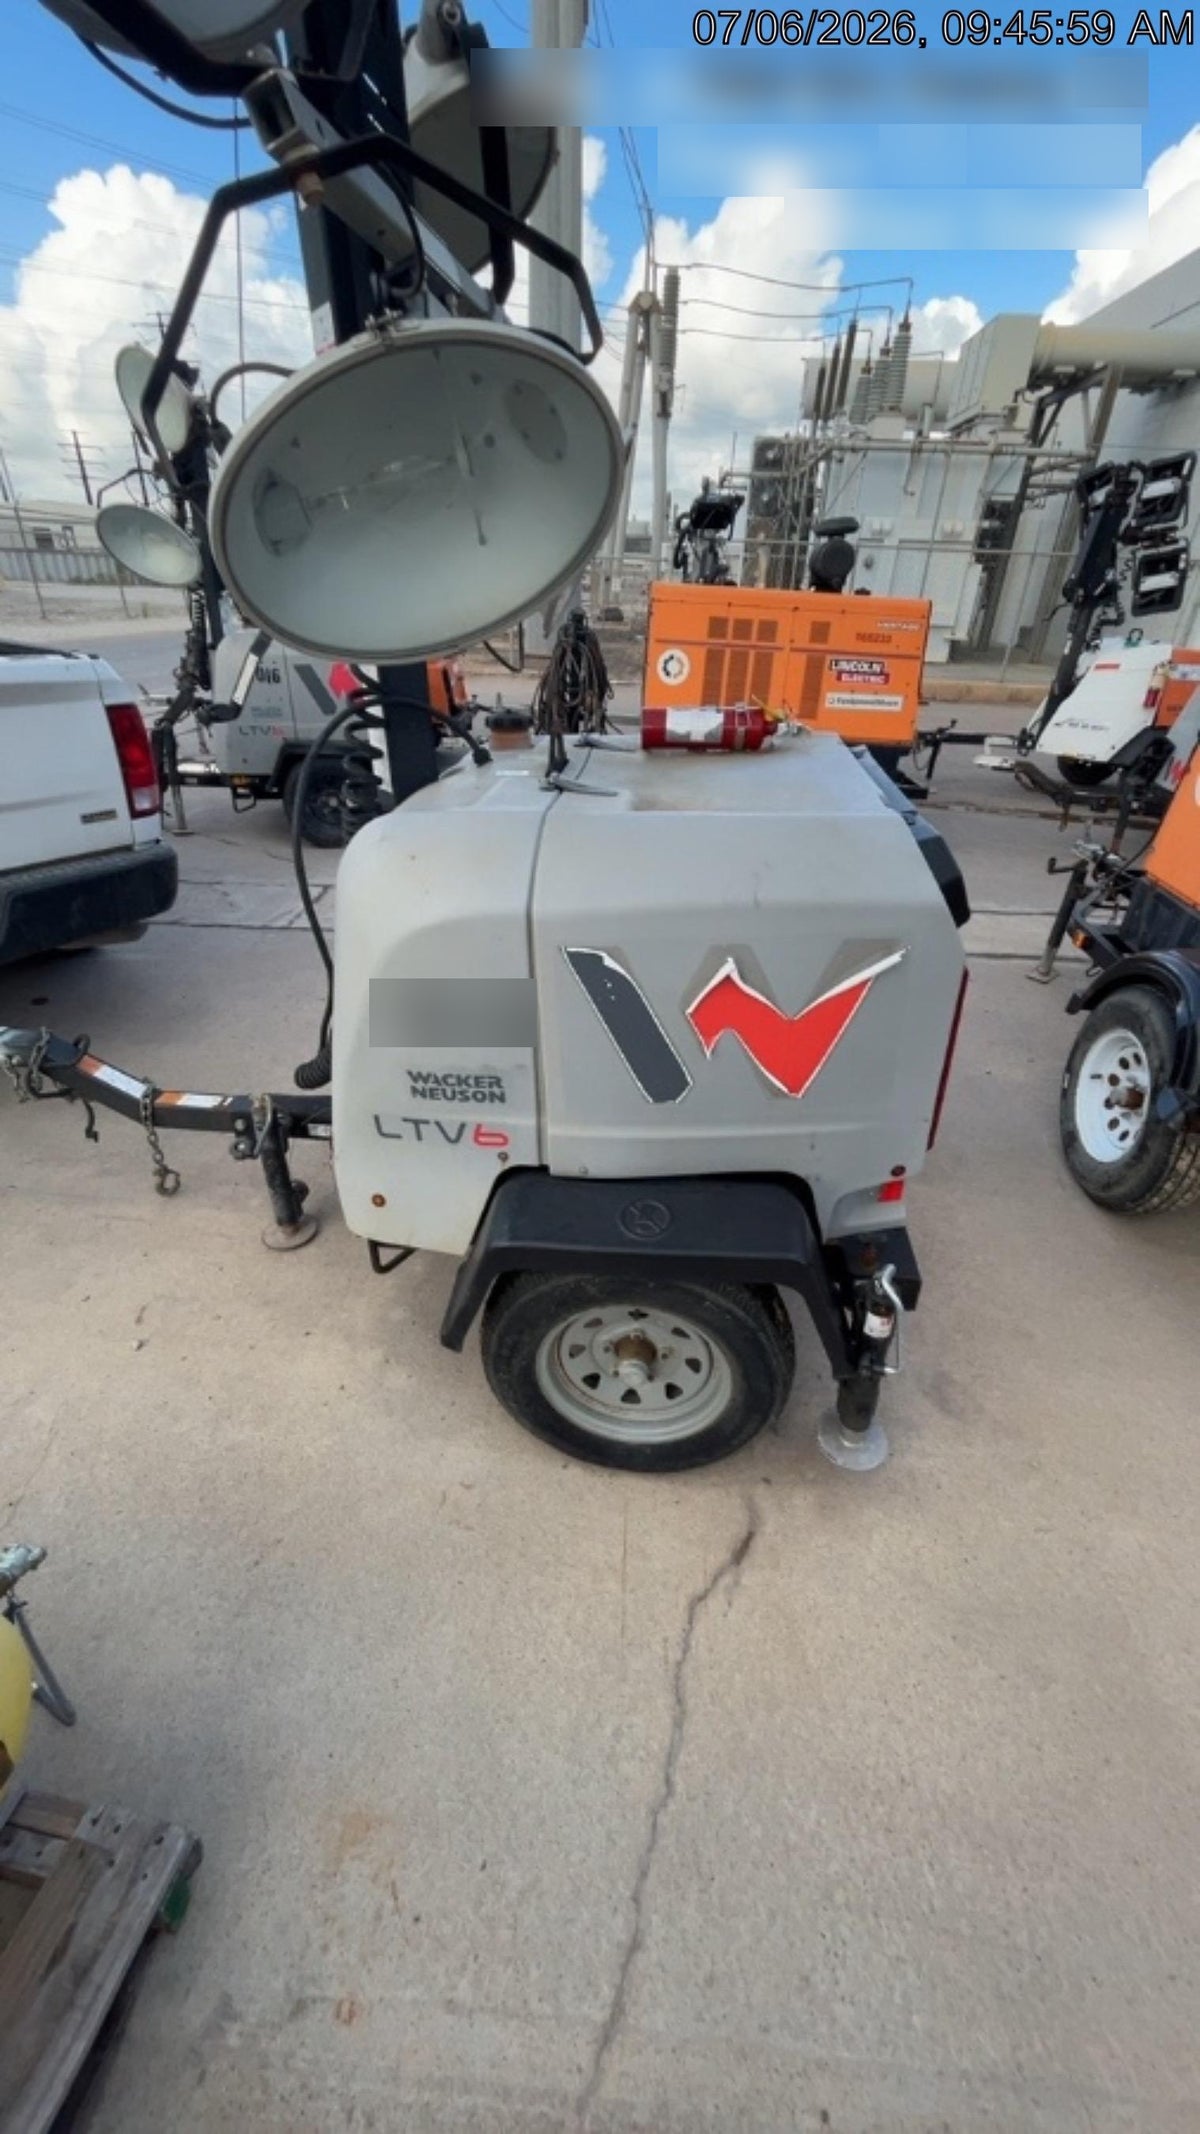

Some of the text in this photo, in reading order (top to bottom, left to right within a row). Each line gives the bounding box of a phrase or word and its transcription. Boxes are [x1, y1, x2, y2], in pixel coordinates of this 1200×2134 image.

[831, 660, 882, 674] LINCOLN
[406, 1070, 504, 1089] WACKER
[410, 1086, 506, 1104] NEUSON
[373, 1113, 510, 1148] LTV6
